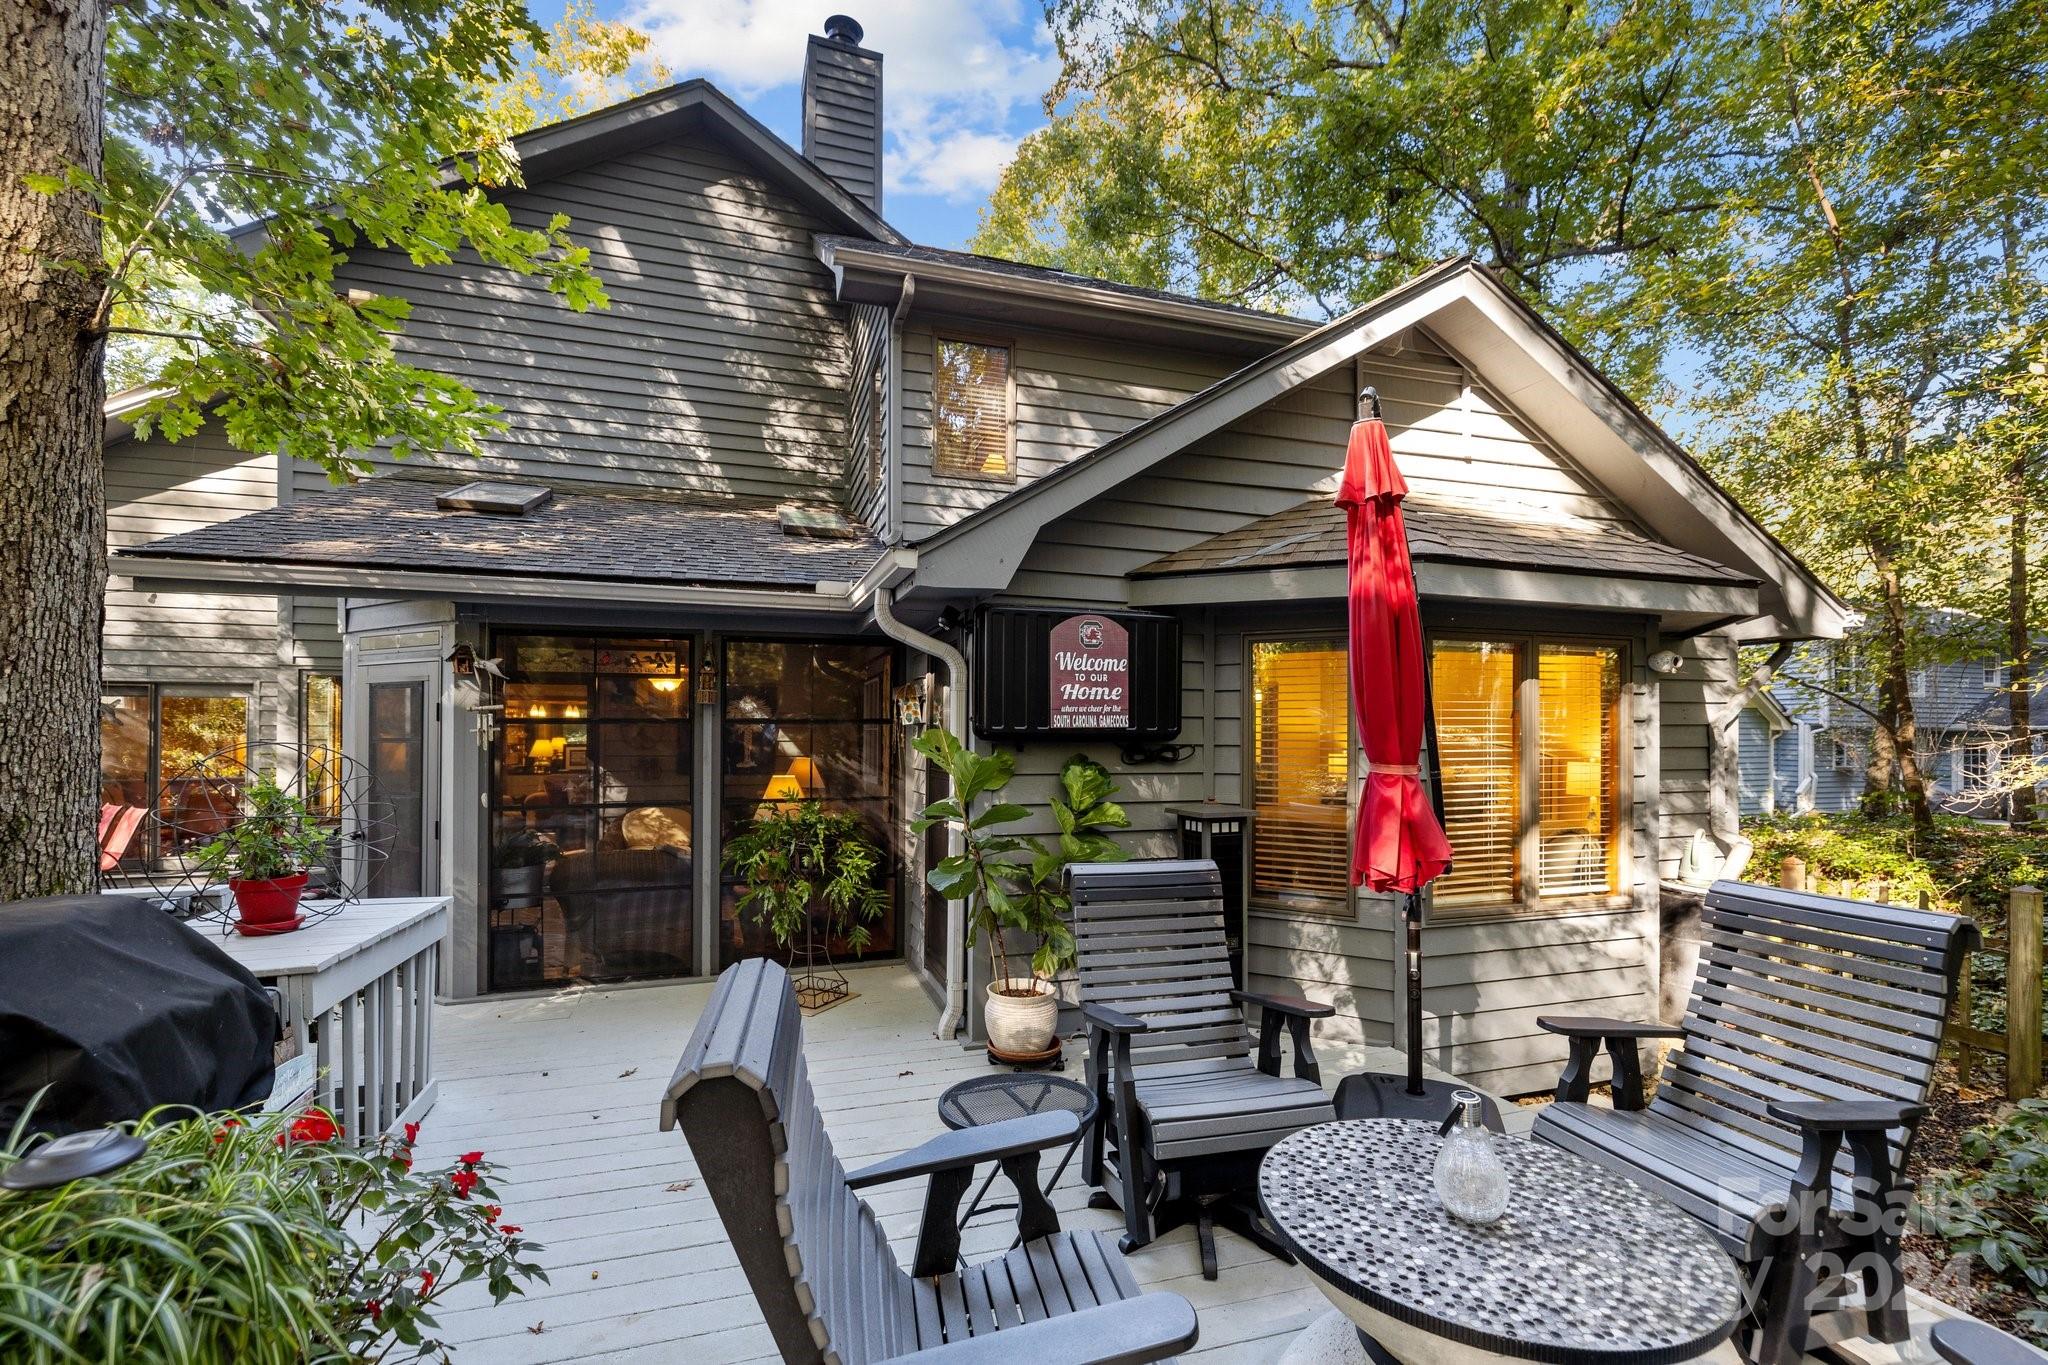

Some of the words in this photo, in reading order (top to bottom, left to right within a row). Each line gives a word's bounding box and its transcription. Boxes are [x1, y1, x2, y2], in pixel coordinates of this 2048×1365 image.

[1055, 651, 1128, 671] Welcome
[1060, 683, 1122, 700] Home
[1061, 705, 1078, 713] where
[1088, 705, 1103, 713] cheer
[1102, 704, 1112, 714] for
[1112, 705, 1121, 713] the
[1053, 715, 1071, 727] SOUTH
[1072, 715, 1097, 727] CAROLINA
[1099, 715, 1129, 727] GAMECOCKS
